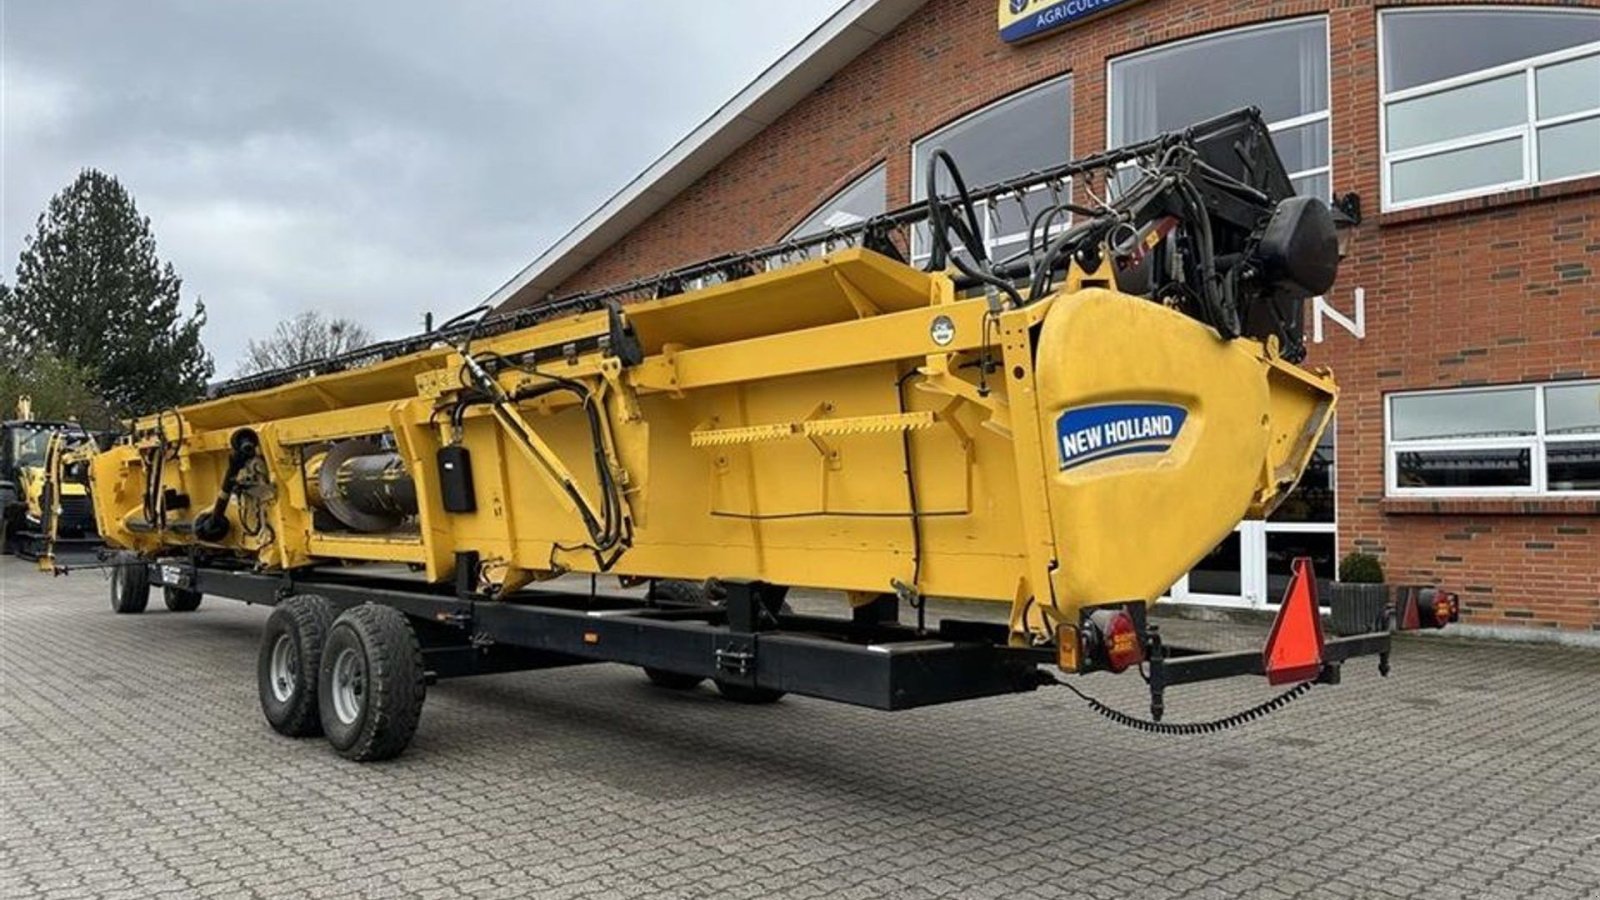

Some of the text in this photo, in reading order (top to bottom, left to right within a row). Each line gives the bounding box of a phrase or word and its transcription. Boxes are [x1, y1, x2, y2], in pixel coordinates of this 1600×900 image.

[1036, 0, 1110, 27] AGRICUL
[1062, 415, 1173, 458] NEW HOLLAND
